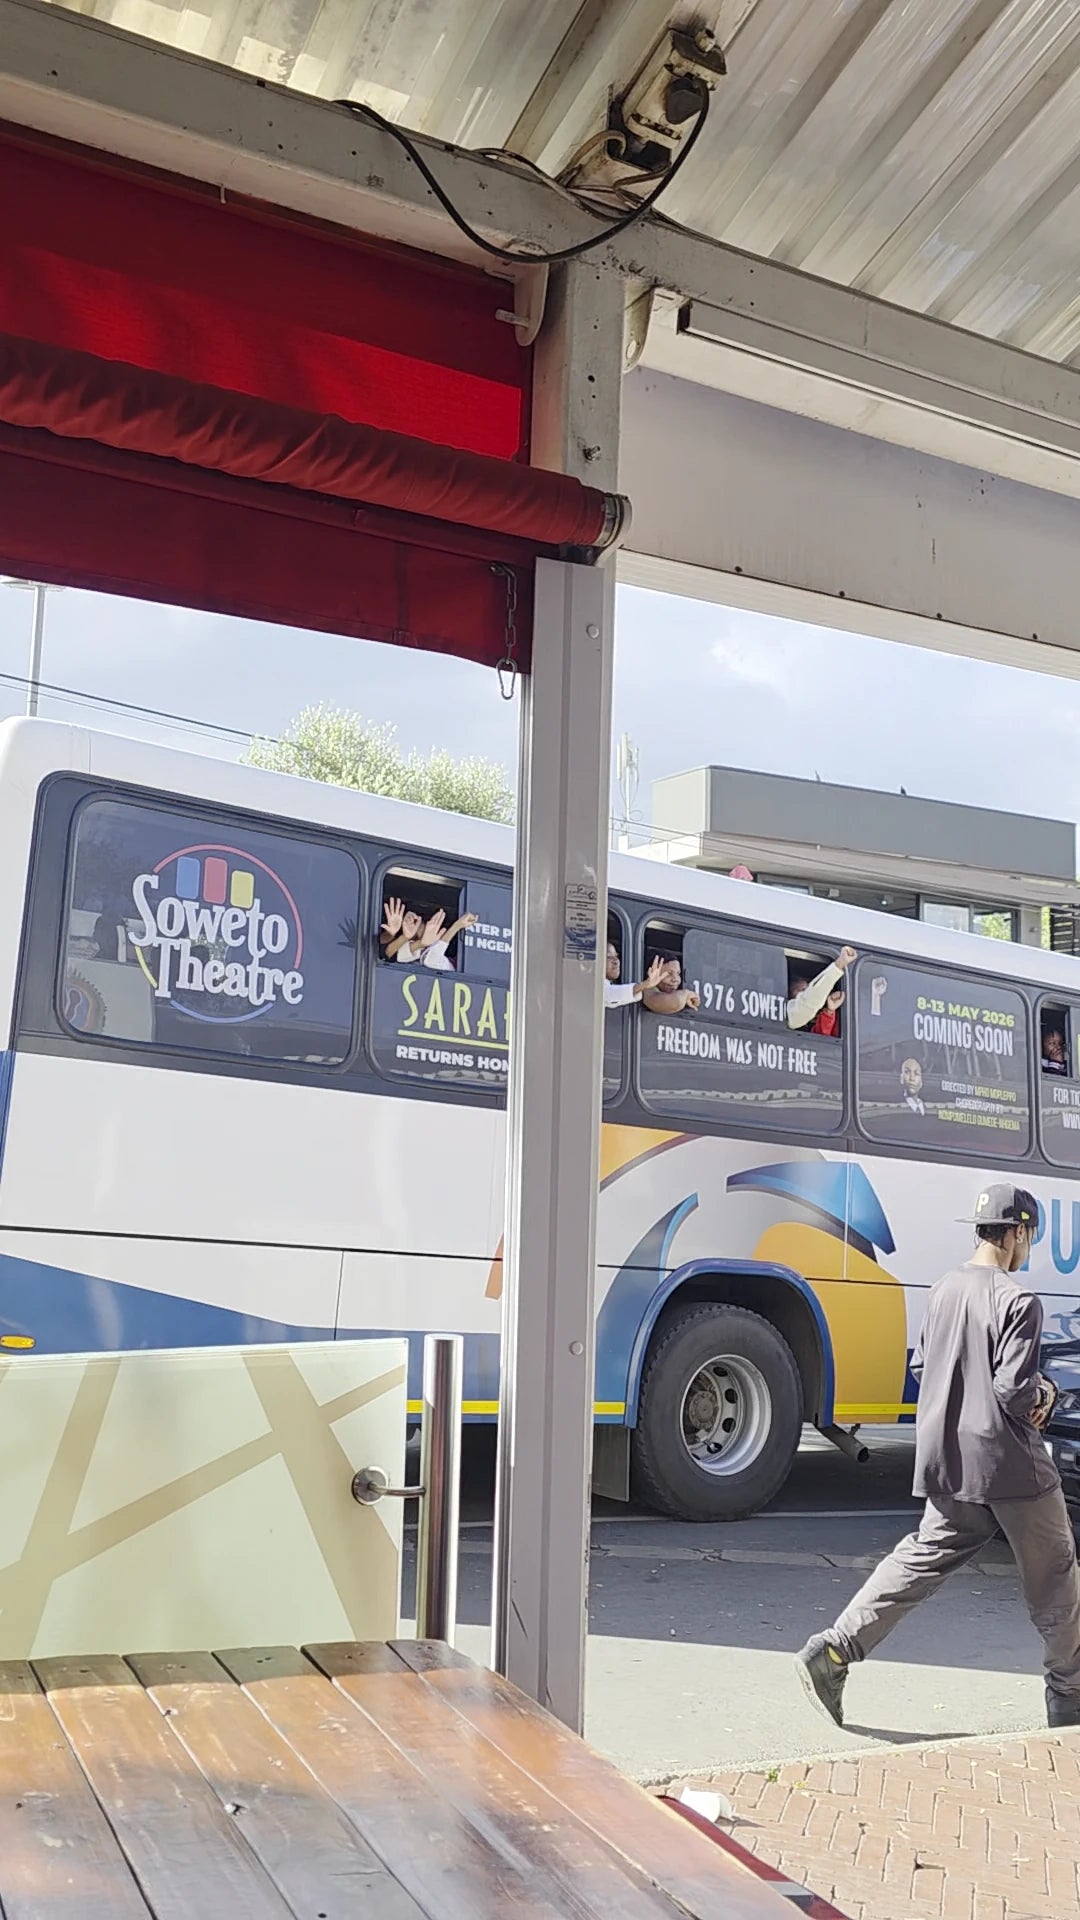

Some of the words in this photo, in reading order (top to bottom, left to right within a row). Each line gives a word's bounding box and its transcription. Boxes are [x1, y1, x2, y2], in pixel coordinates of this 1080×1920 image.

[128, 873, 289, 957] Soweto
[151, 936, 304, 1006] Theatre
[402, 974, 511, 1041] SARA
[741, 989, 787, 1021] SOWET
[917, 996, 945, 1014] 8-13
[948, 1002, 980, 1021] MAY
[982, 1009, 1015, 1028] 2026
[656, 1025, 720, 1061] FREEDOM
[726, 1037, 752, 1065] WAS
[757, 1042, 784, 1071] NOT
[787, 1048, 817, 1076] FREE
[913, 1013, 972, 1049] COMING
[974, 1024, 1013, 1057] SOON
[396, 1045, 474, 1068] RETURNS
[1053, 1087, 1069, 1105] FOR
[978, 1193, 989, 1212] P
